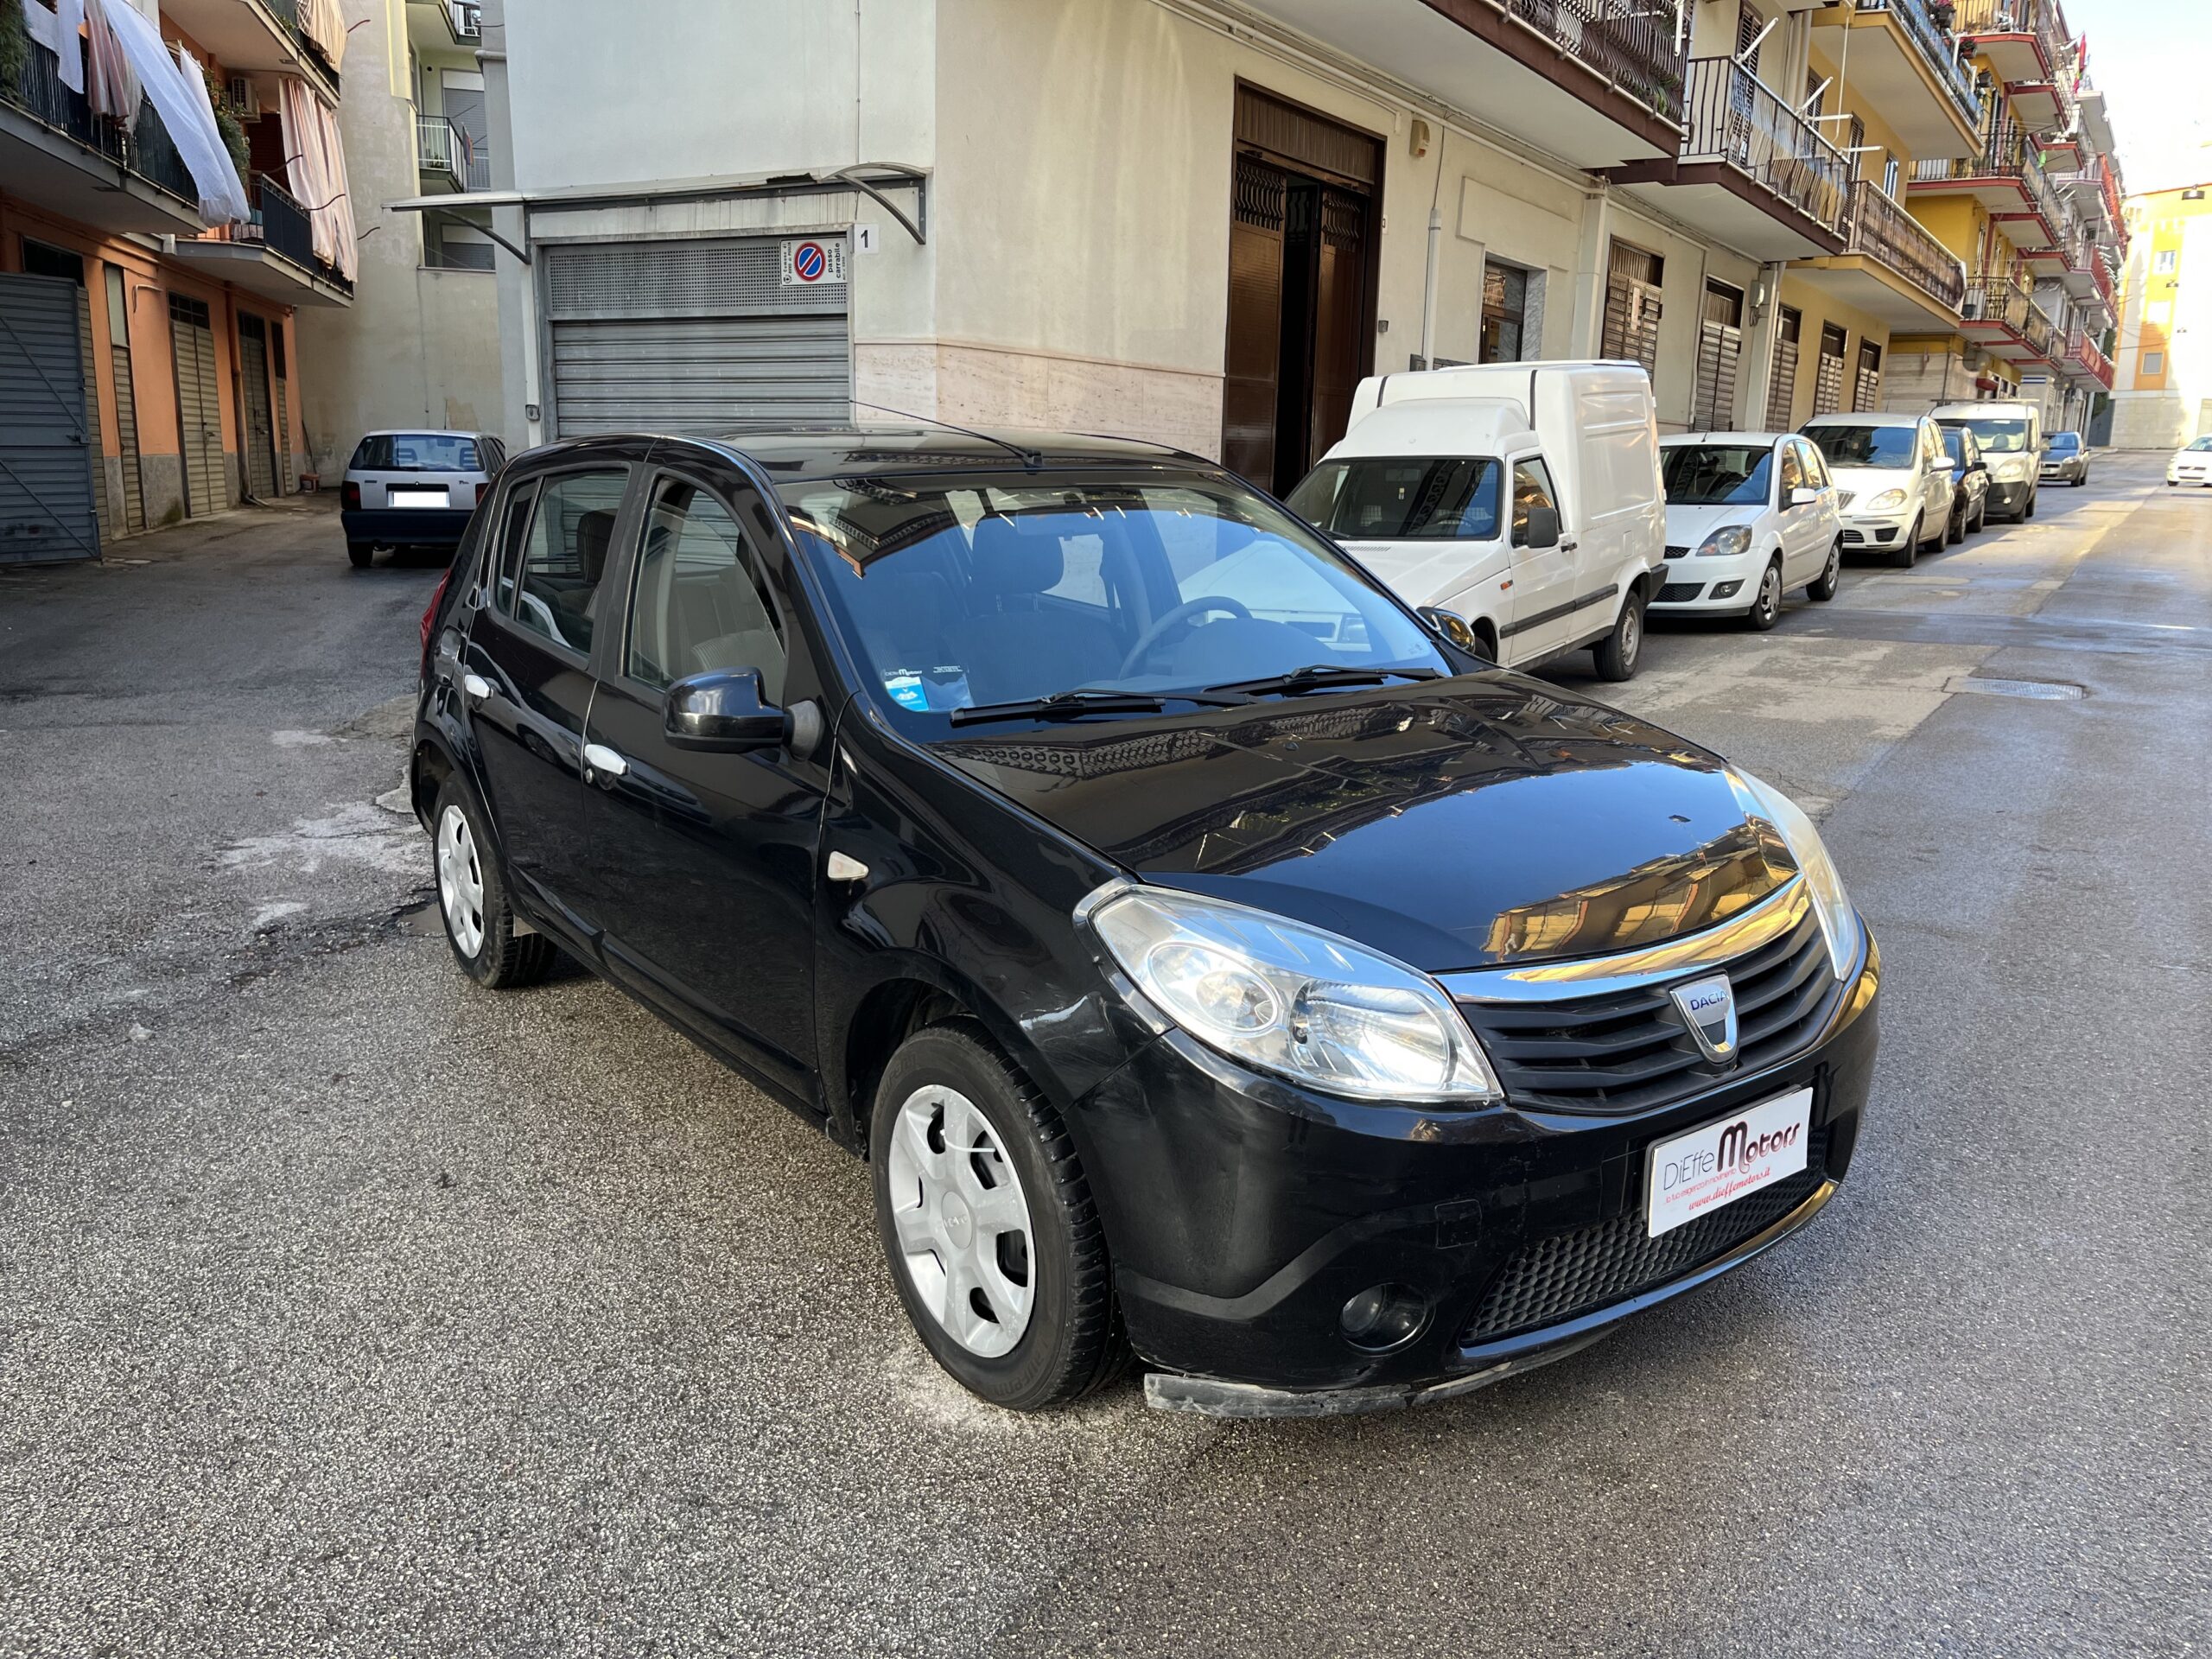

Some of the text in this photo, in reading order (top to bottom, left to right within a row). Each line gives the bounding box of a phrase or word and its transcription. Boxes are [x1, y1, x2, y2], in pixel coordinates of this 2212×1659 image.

[861, 229, 868, 248] 1
[1690, 990, 1729, 1012] DACIA
[1663, 1121, 1801, 1191] DiEffe Motors
[1688, 1166, 1771, 1211] www.dieffemotors.it
